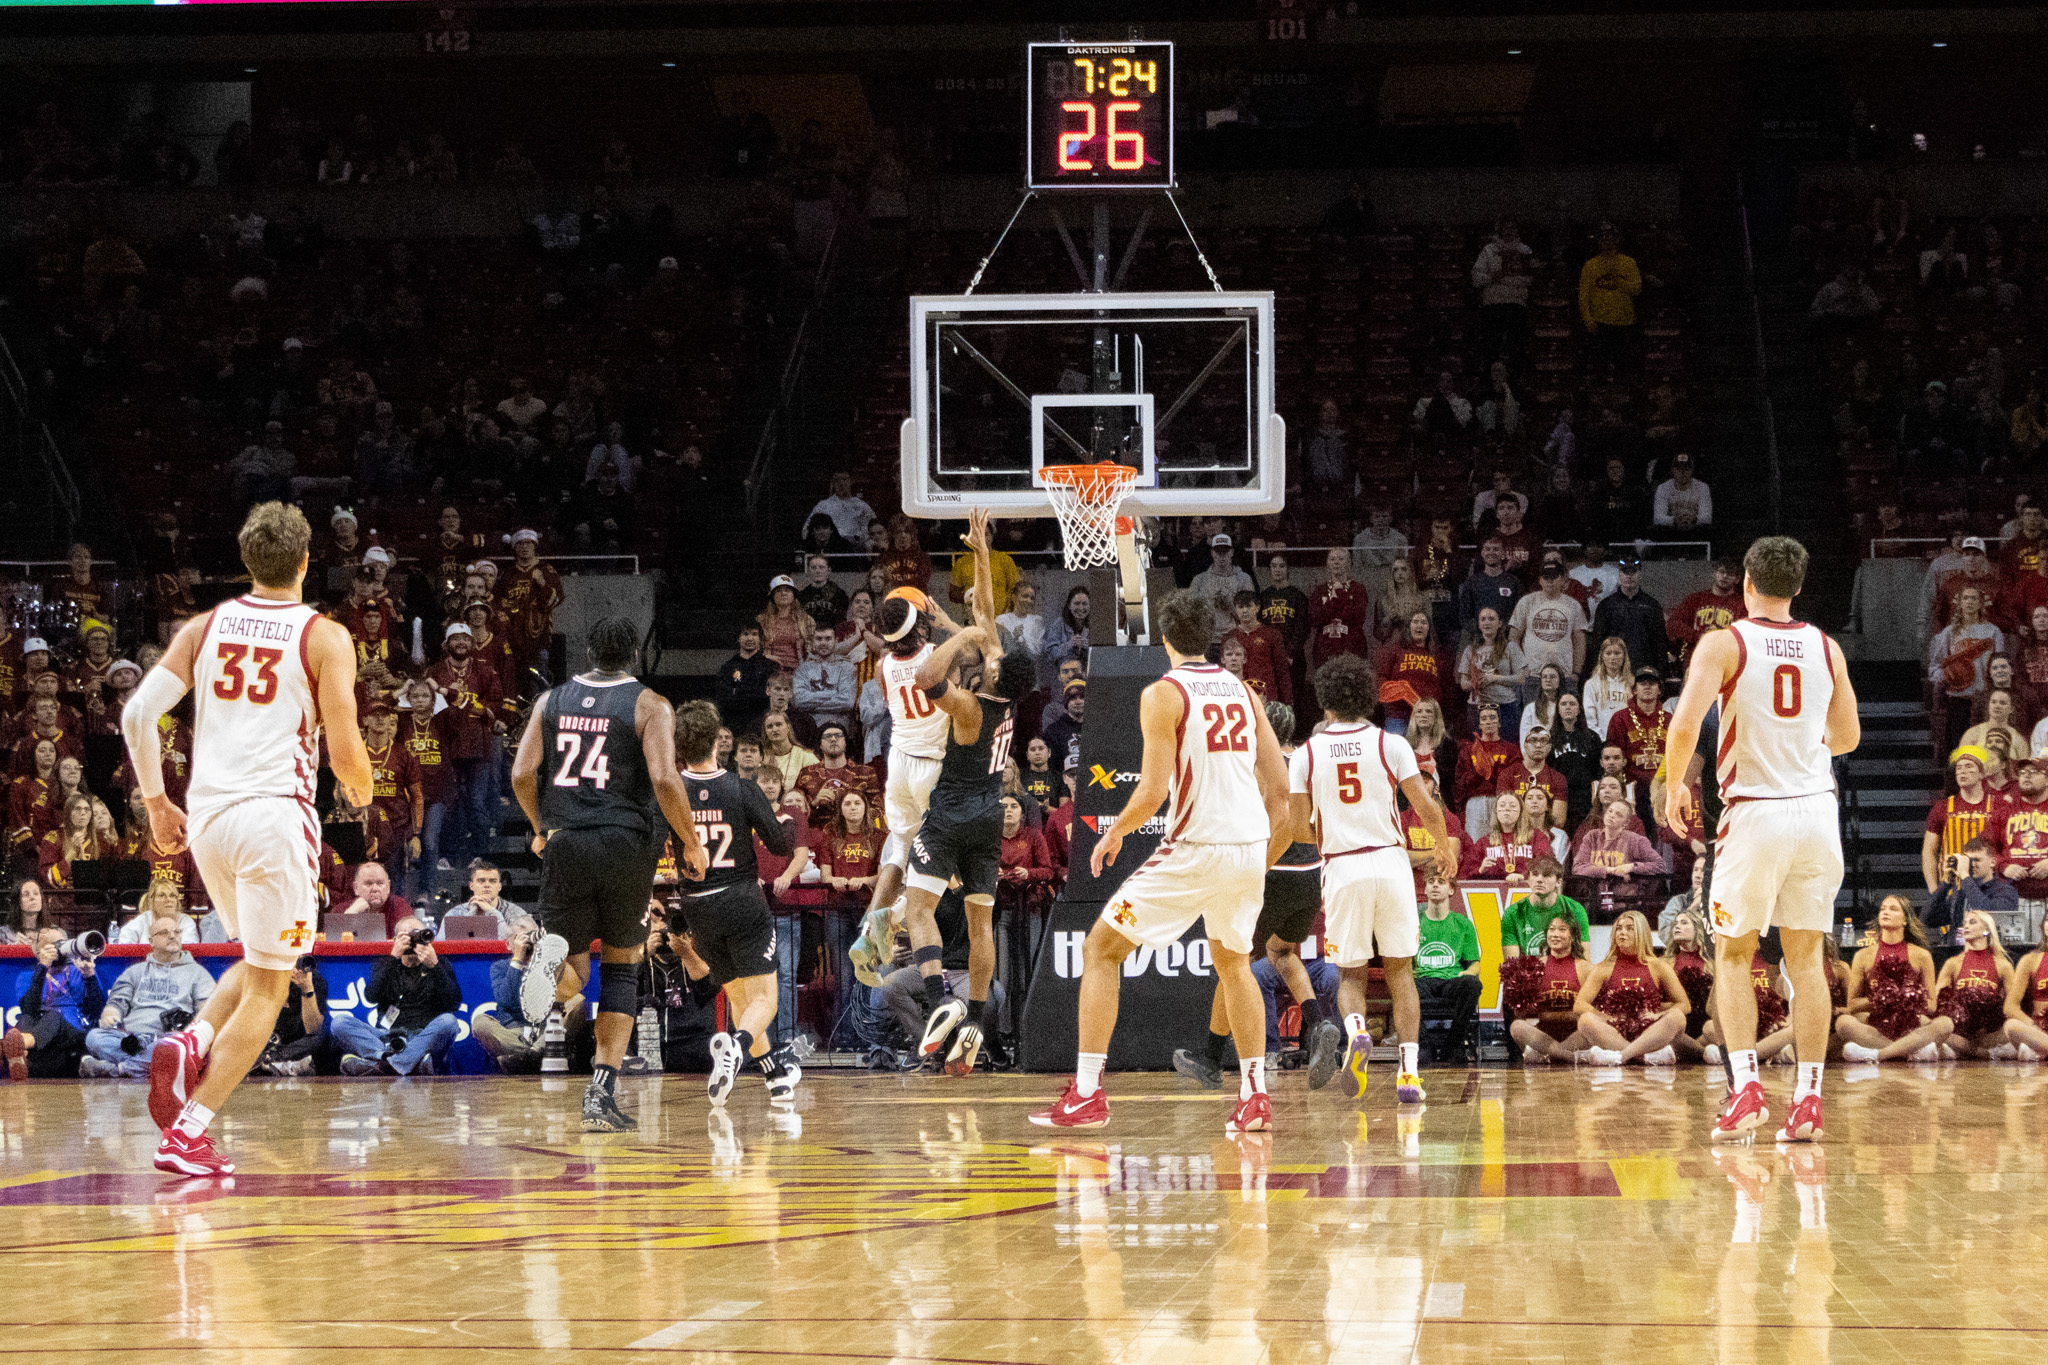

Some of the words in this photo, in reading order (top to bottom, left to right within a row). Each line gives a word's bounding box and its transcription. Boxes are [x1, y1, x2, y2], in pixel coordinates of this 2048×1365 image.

[1267, 19, 1307, 40] 101
[424, 30, 471, 53] 142
[1067, 46, 1136, 54] DAKTRONICS
[1074, 58, 1157, 97] 7:24
[1058, 101, 1144, 170] 26
[927, 494, 961, 503] SPALDING
[219, 616, 294, 642] CHATFIELD
[1404, 653, 1436, 664] IOWA
[1765, 637, 1804, 659] HEISE
[213, 643, 284, 706] 33
[891, 665, 919, 683] GILBE
[1399, 662, 1438, 676] STATE
[899, 683, 937, 720] 10
[1187, 681, 1245, 699] MOMCILOVIC
[1773, 664, 1802, 719] 0
[559, 715, 610, 733] ONDEKANE
[1202, 703, 1249, 753] 22
[553, 732, 611, 790] 24
[988, 730, 1014, 775] 10
[1329, 741, 1362, 758] JONES
[1337, 762, 1363, 805] 5
[912, 834, 931, 865] MAVS
[279, 925, 312, 944] STATE
